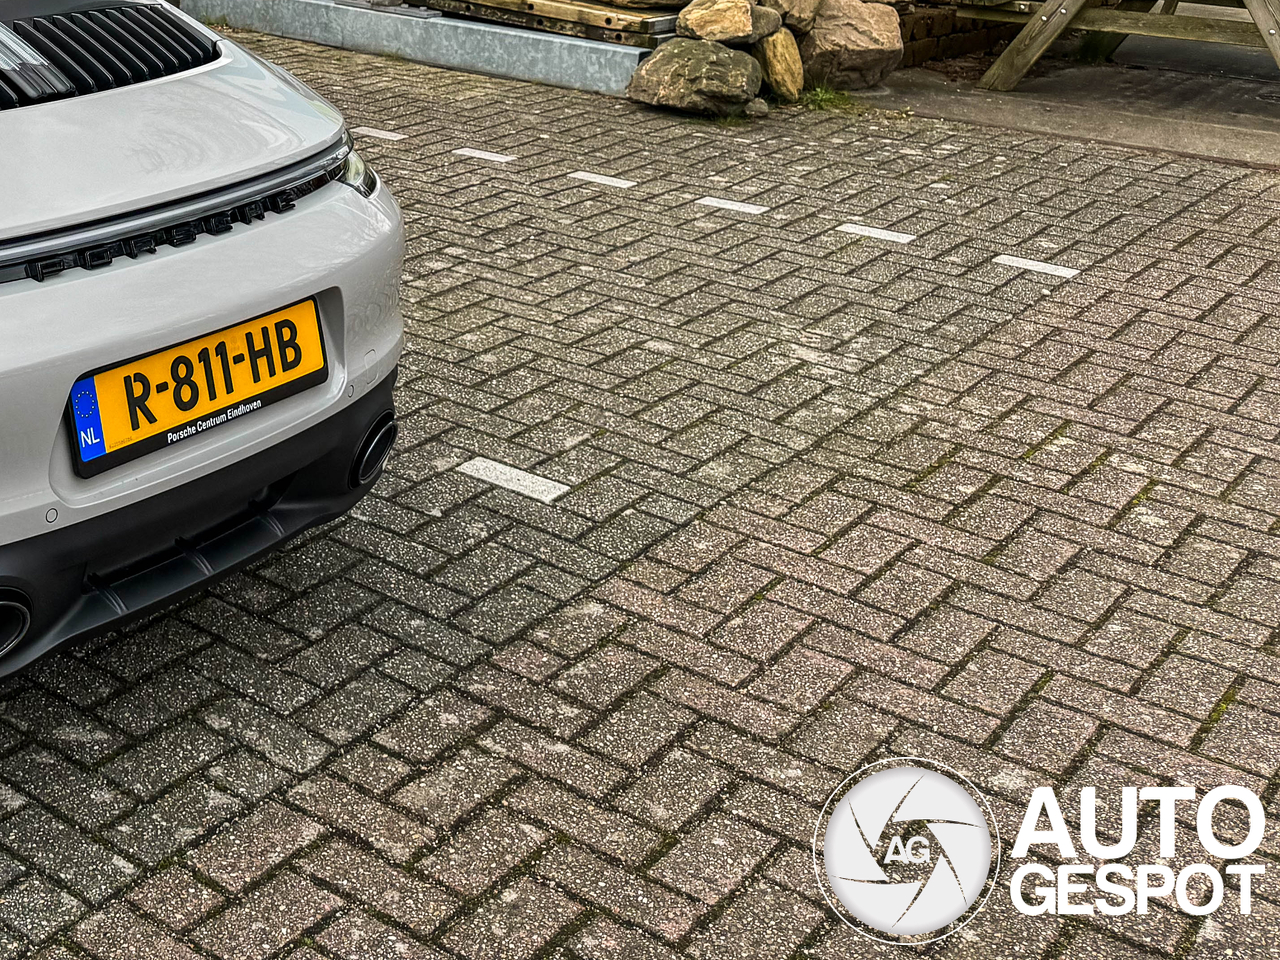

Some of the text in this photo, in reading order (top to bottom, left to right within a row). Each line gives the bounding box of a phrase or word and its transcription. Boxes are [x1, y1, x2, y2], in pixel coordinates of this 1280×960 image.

[123, 318, 302, 431] R-811-HB
[80, 427, 101, 448] NL
[167, 399, 262, 444] Porsche Centrum Eindhoven
